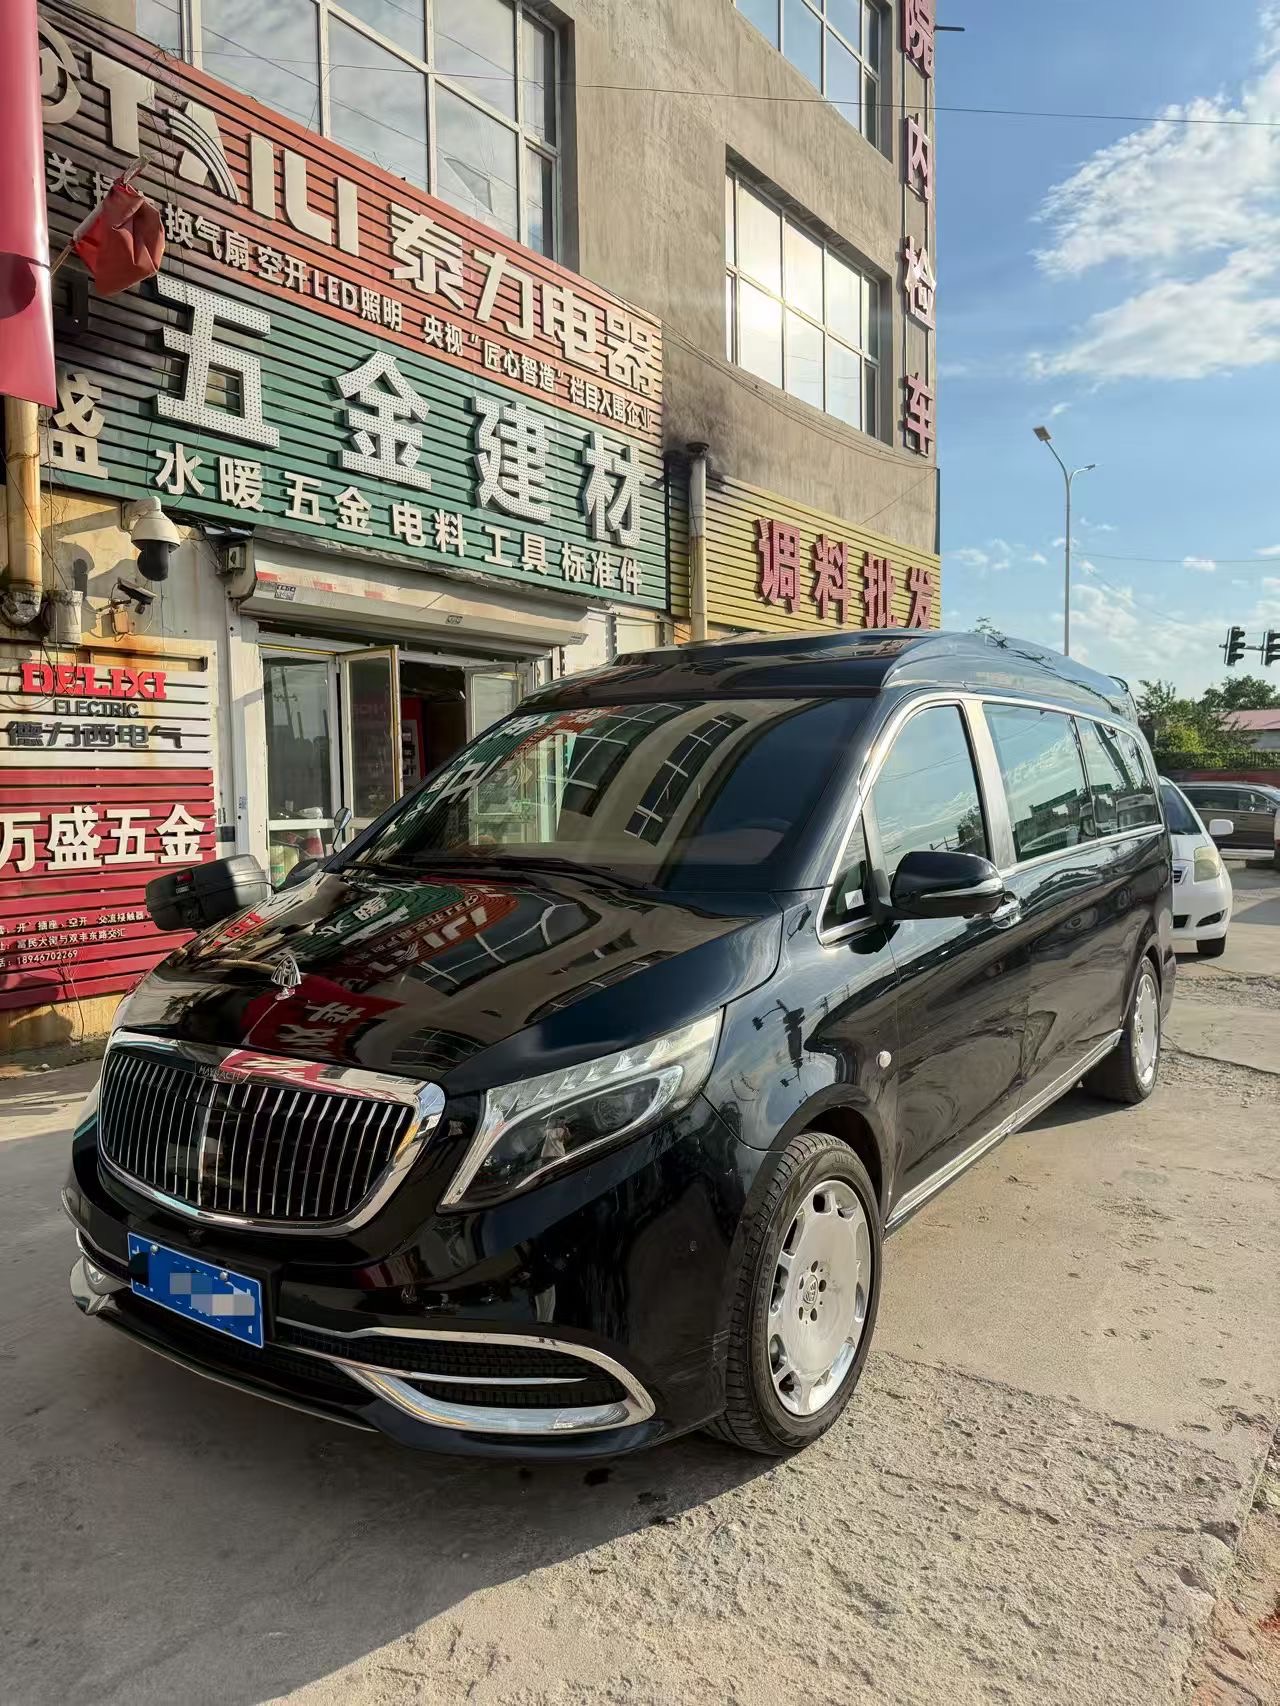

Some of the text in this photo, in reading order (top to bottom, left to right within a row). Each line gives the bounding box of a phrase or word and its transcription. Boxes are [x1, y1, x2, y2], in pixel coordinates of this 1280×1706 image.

[390, 202, 655, 398] 泰力电器
[155, 274, 646, 547] 五金建材
[755, 516, 935, 630] 调料批发
[20, 662, 167, 700] DELIXI
[53, 698, 140, 718] ELECTRIC
[7, 720, 183, 749] 德力西电气
[0, 803, 205, 872] 万盛五金
